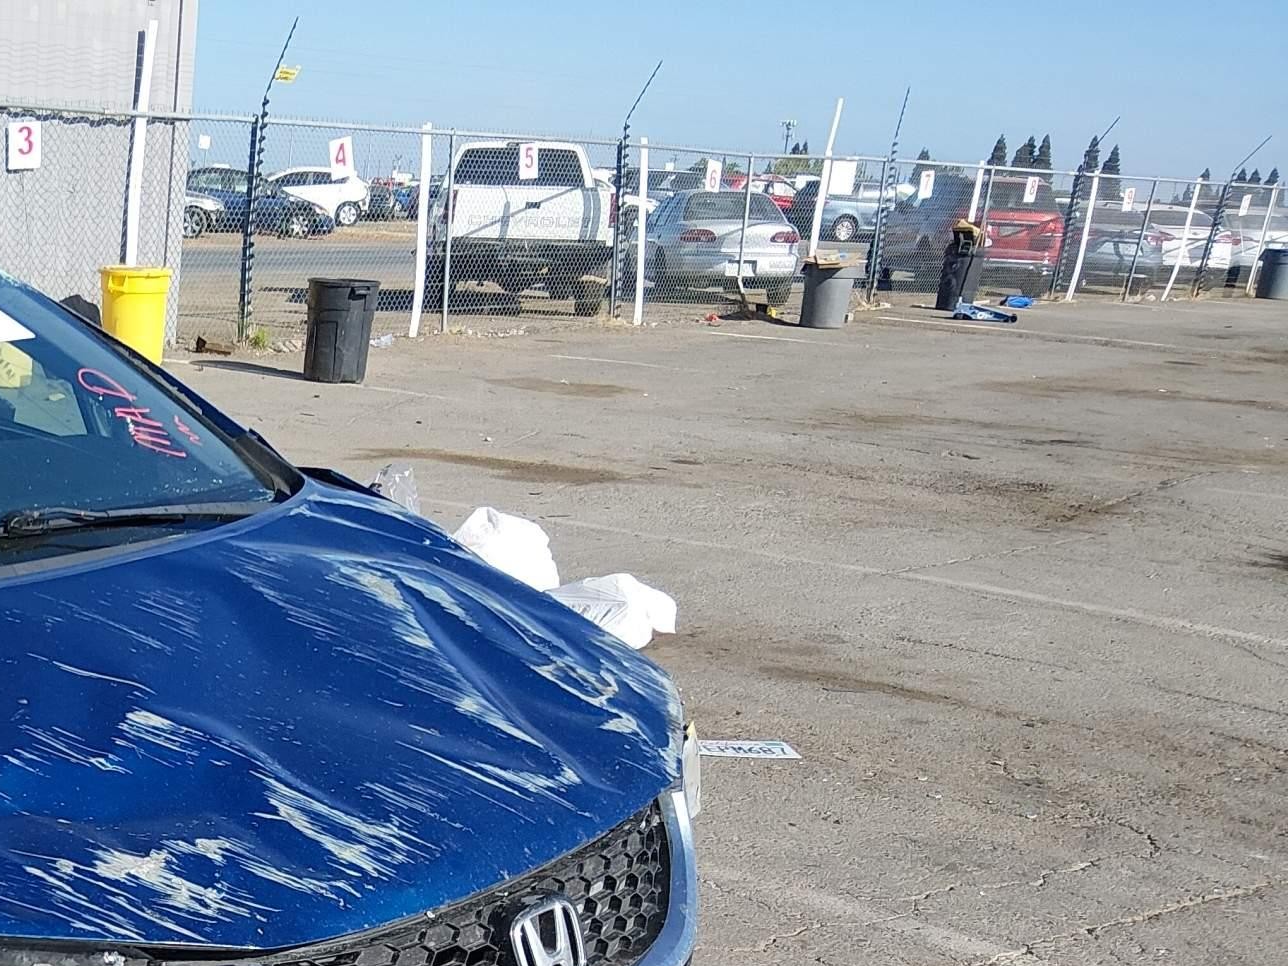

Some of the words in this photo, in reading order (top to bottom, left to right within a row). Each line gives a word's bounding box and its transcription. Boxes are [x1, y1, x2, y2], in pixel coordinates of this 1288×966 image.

[18, 126, 33, 155] 3
[335, 142, 346, 166] 4
[525, 147, 533, 168] 5
[710, 170, 717, 188] 6
